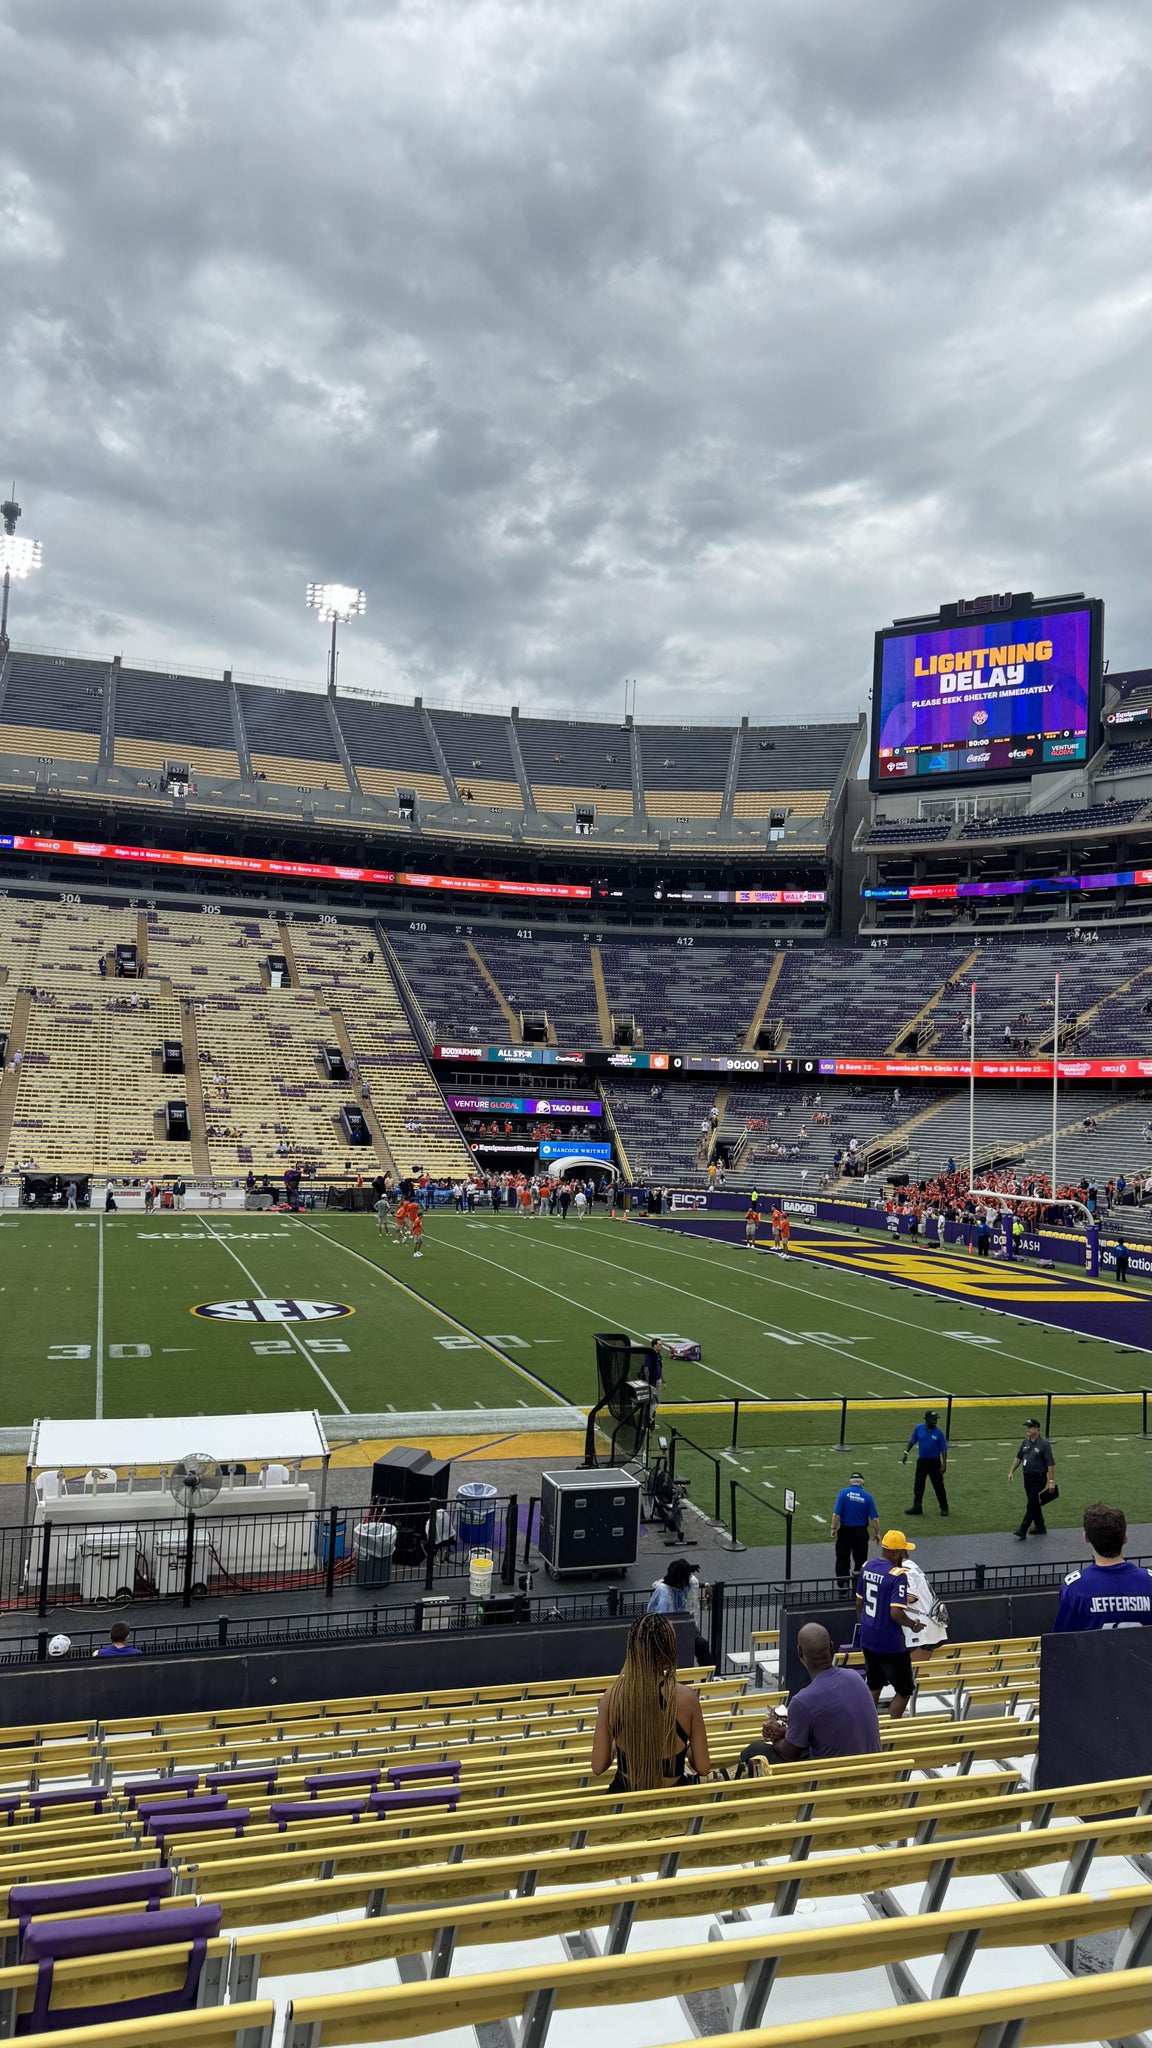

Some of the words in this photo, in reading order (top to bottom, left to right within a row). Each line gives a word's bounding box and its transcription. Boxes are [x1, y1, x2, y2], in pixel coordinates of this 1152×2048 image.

[957, 592, 1013, 618] LSU
[914, 640, 1053, 677] LIGHTNING
[940, 664, 1025, 693] DELAY
[911, 697, 941, 708] PLEASE
[942, 695, 962, 705] SEEK
[963, 692, 998, 702] SHELTER
[999, 684, 1054, 697] IMMEDIATELY
[1116, 709, 1148, 718] Equipment
[1051, 743, 1079, 751] VENTURE
[1008, 749, 1027, 758] efcu
[115, 848, 129, 857] Sign
[146, 851, 161, 859] Save
[183, 855, 213, 864] Download
[249, 861, 262, 869] App
[60, 893, 81, 904] 304
[201, 904, 221, 915] 305
[318, 914, 337, 924] 306
[410, 922, 427, 931] 410
[517, 930, 532, 939] 411
[677, 937, 693, 946] 412
[870, 938, 888, 948] 413
[441, 1047, 482, 1058] BODYARMOR
[497, 1049, 512, 1058] ALL
[674, 1058, 681, 1067] 0
[726, 1060, 759, 1070] 90:00
[787, 1063, 792, 1071] 1
[805, 1062, 813, 1071] 0
[886, 1064, 919, 1072] Download
[983, 1065, 998, 1073] Sign
[454, 1100, 489, 1109] VENTURE
[490, 1102, 519, 1110] GLOBAL
[551, 1104, 571, 1112] TACO
[572, 1105, 591, 1113] BELL
[671, 1193, 707, 1205] EICO
[783, 1201, 815, 1215] BADGER
[205, 1299, 342, 1322] SEC
[47, 1343, 153, 1360] 30
[249, 1338, 351, 1355] 25
[862, 1570, 885, 1585] PICKETT
[898, 1584, 906, 1598] 5
[865, 1582, 878, 1618] 5
[1090, 1596, 1151, 1613] JEFFERSON
